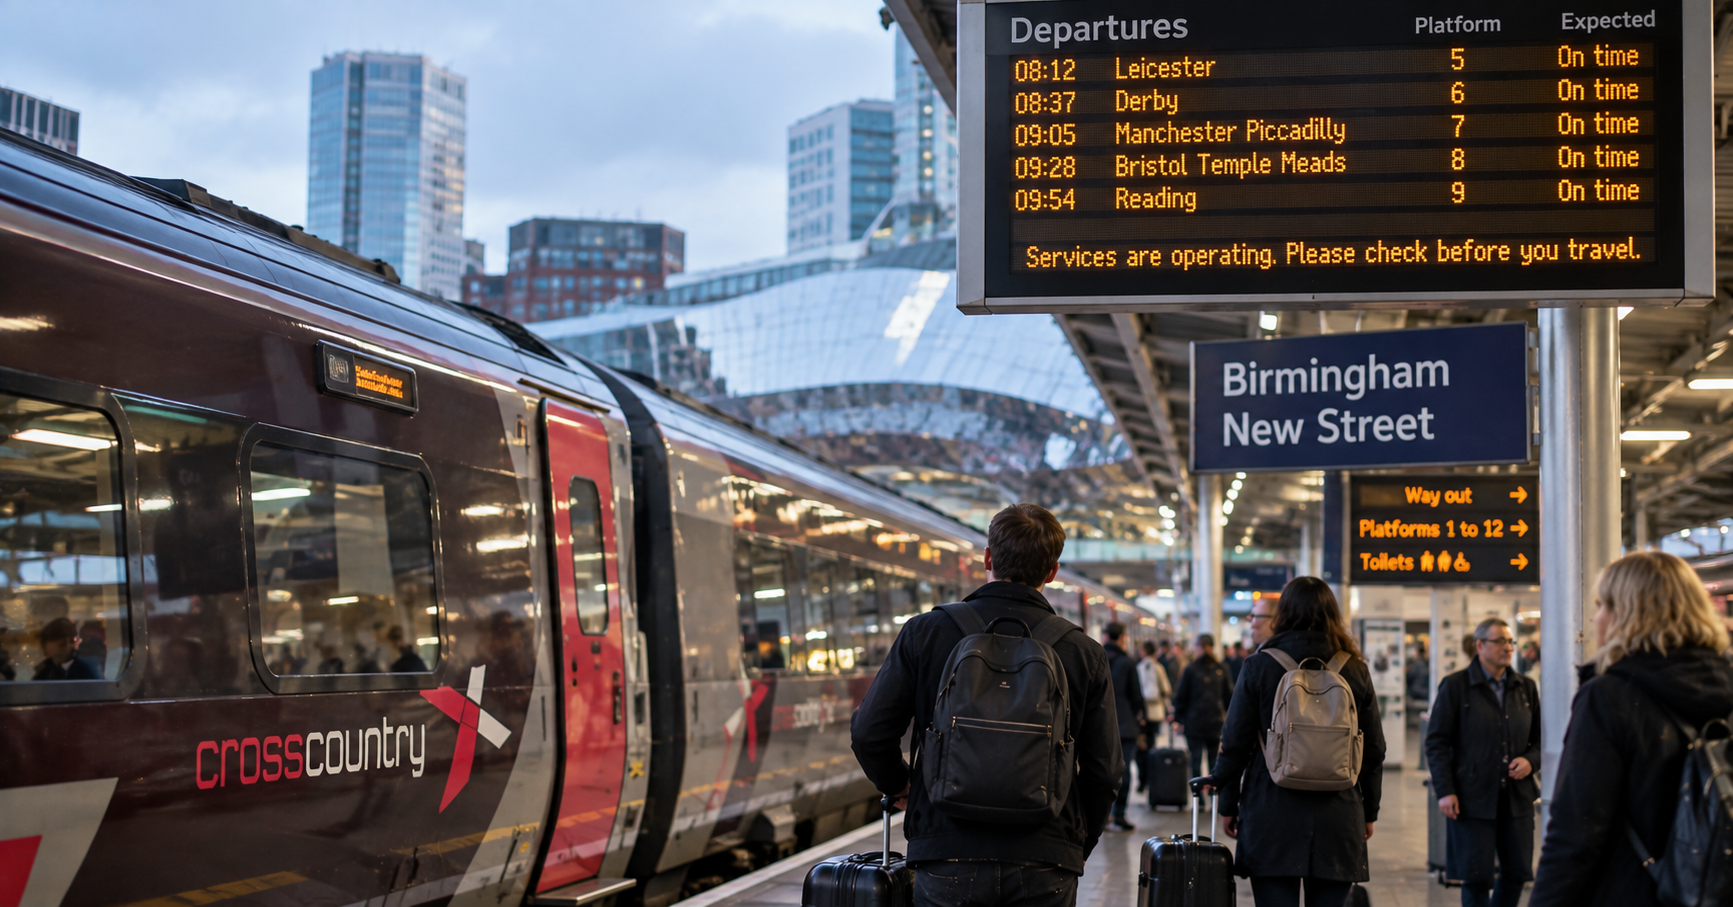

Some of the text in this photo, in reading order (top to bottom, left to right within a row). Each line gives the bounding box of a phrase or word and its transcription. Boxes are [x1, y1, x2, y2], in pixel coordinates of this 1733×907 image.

[1011, 15, 1188, 49] Departures
[1415, 14, 1501, 35] Platform
[1561, 9, 1657, 34] Expected
[1115, 55, 1217, 80] Leicester
[1450, 47, 1465, 71] 5
[1557, 43, 1640, 68] On time
[1014, 58, 1076, 83] 08:12
[1115, 88, 1179, 116] Derby
[1450, 80, 1465, 105] 6
[1557, 77, 1640, 102] On time
[1014, 90, 1076, 115] 08:37
[1014, 122, 1076, 147] 09:05
[1115, 117, 1346, 146] Manchester Piccadilly
[1450, 114, 1466, 138] 7
[1557, 110, 1640, 135] On time
[1014, 155, 1076, 180] 09:28
[1115, 149, 1347, 180] Bristol Temple Meads
[1451, 147, 1466, 171] 8
[1557, 144, 1640, 169] On time
[1014, 187, 1076, 212] 09:54
[1115, 185, 1197, 213] Reading
[1451, 181, 1466, 204] 9
[1557, 177, 1640, 202] On time
[1025, 235, 1641, 271] Services are operating. Please check before you travel.
[1222, 353, 1451, 401] Birmingham
[1222, 406, 1436, 448] New Street
[1404, 486, 1473, 508] Way out
[1359, 518, 1504, 538] Platforms 1 to 12
[1359, 552, 1415, 572] Toilets
[195, 716, 427, 790] crosscountry
